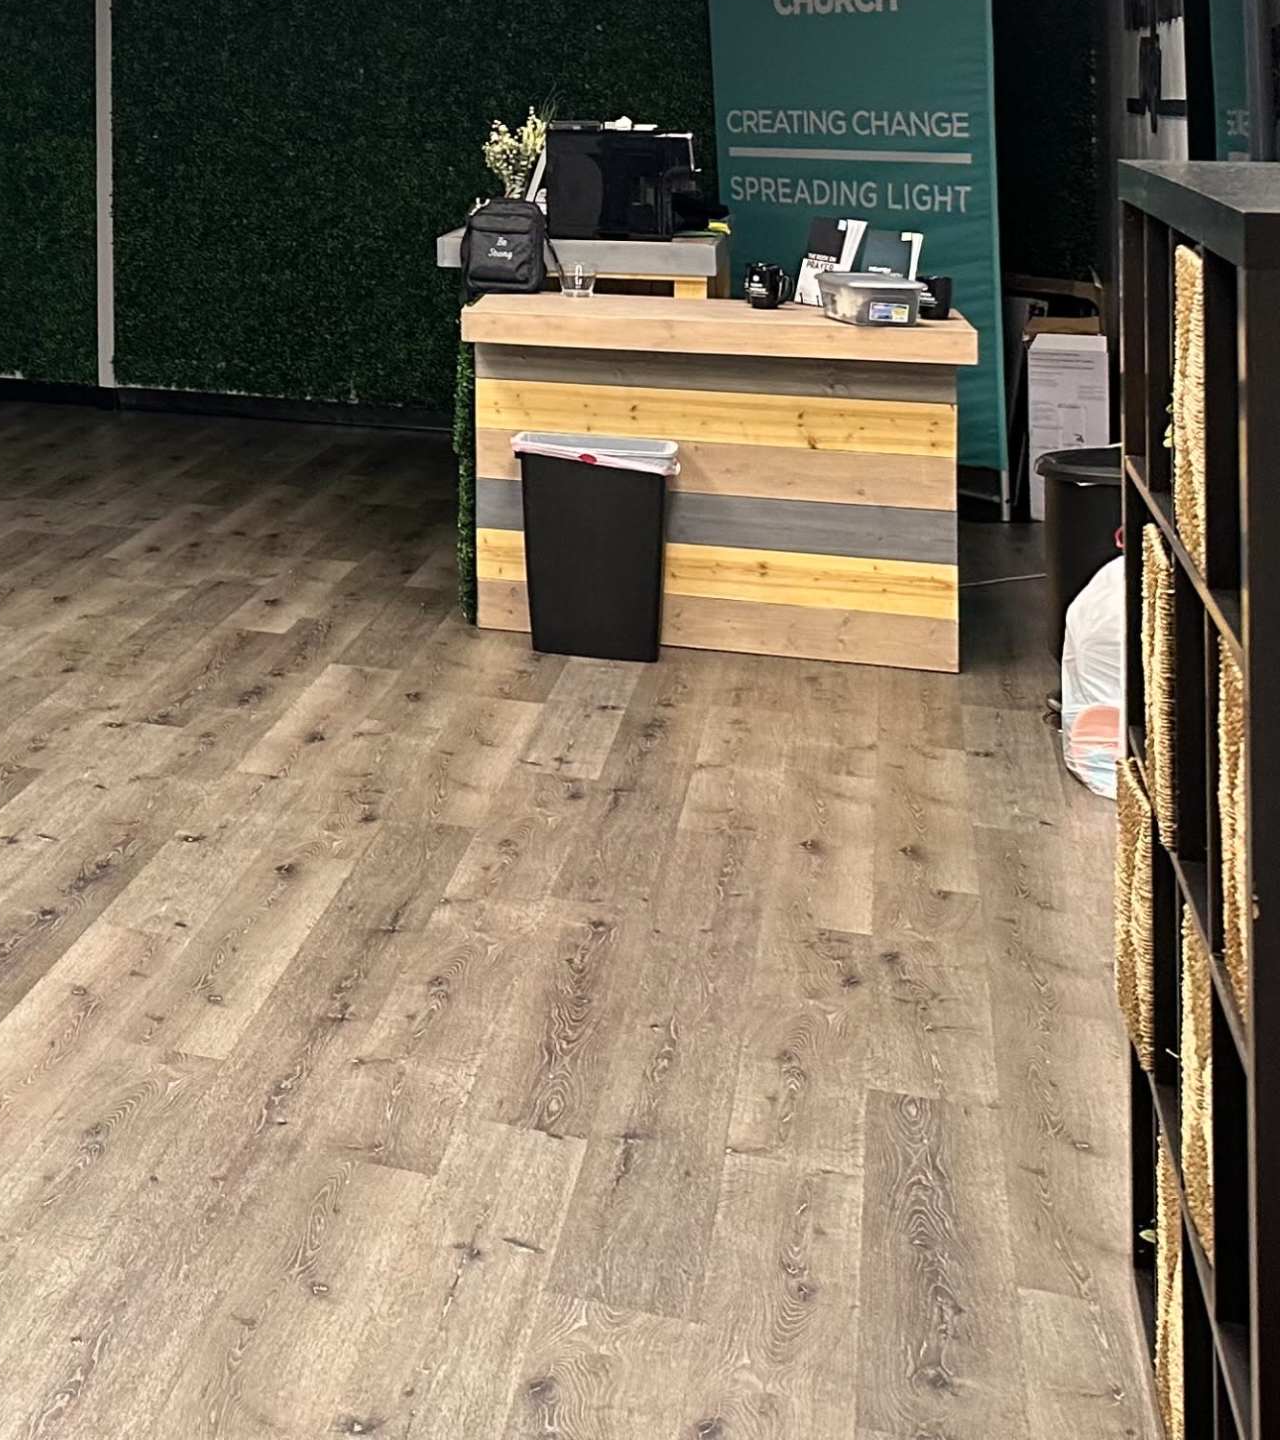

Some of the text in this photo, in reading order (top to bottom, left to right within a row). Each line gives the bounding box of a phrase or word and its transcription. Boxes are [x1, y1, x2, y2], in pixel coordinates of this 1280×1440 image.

[726, 109, 970, 138] CREATING CHANGE
[730, 176, 972, 213] SPREADING LIGHT
